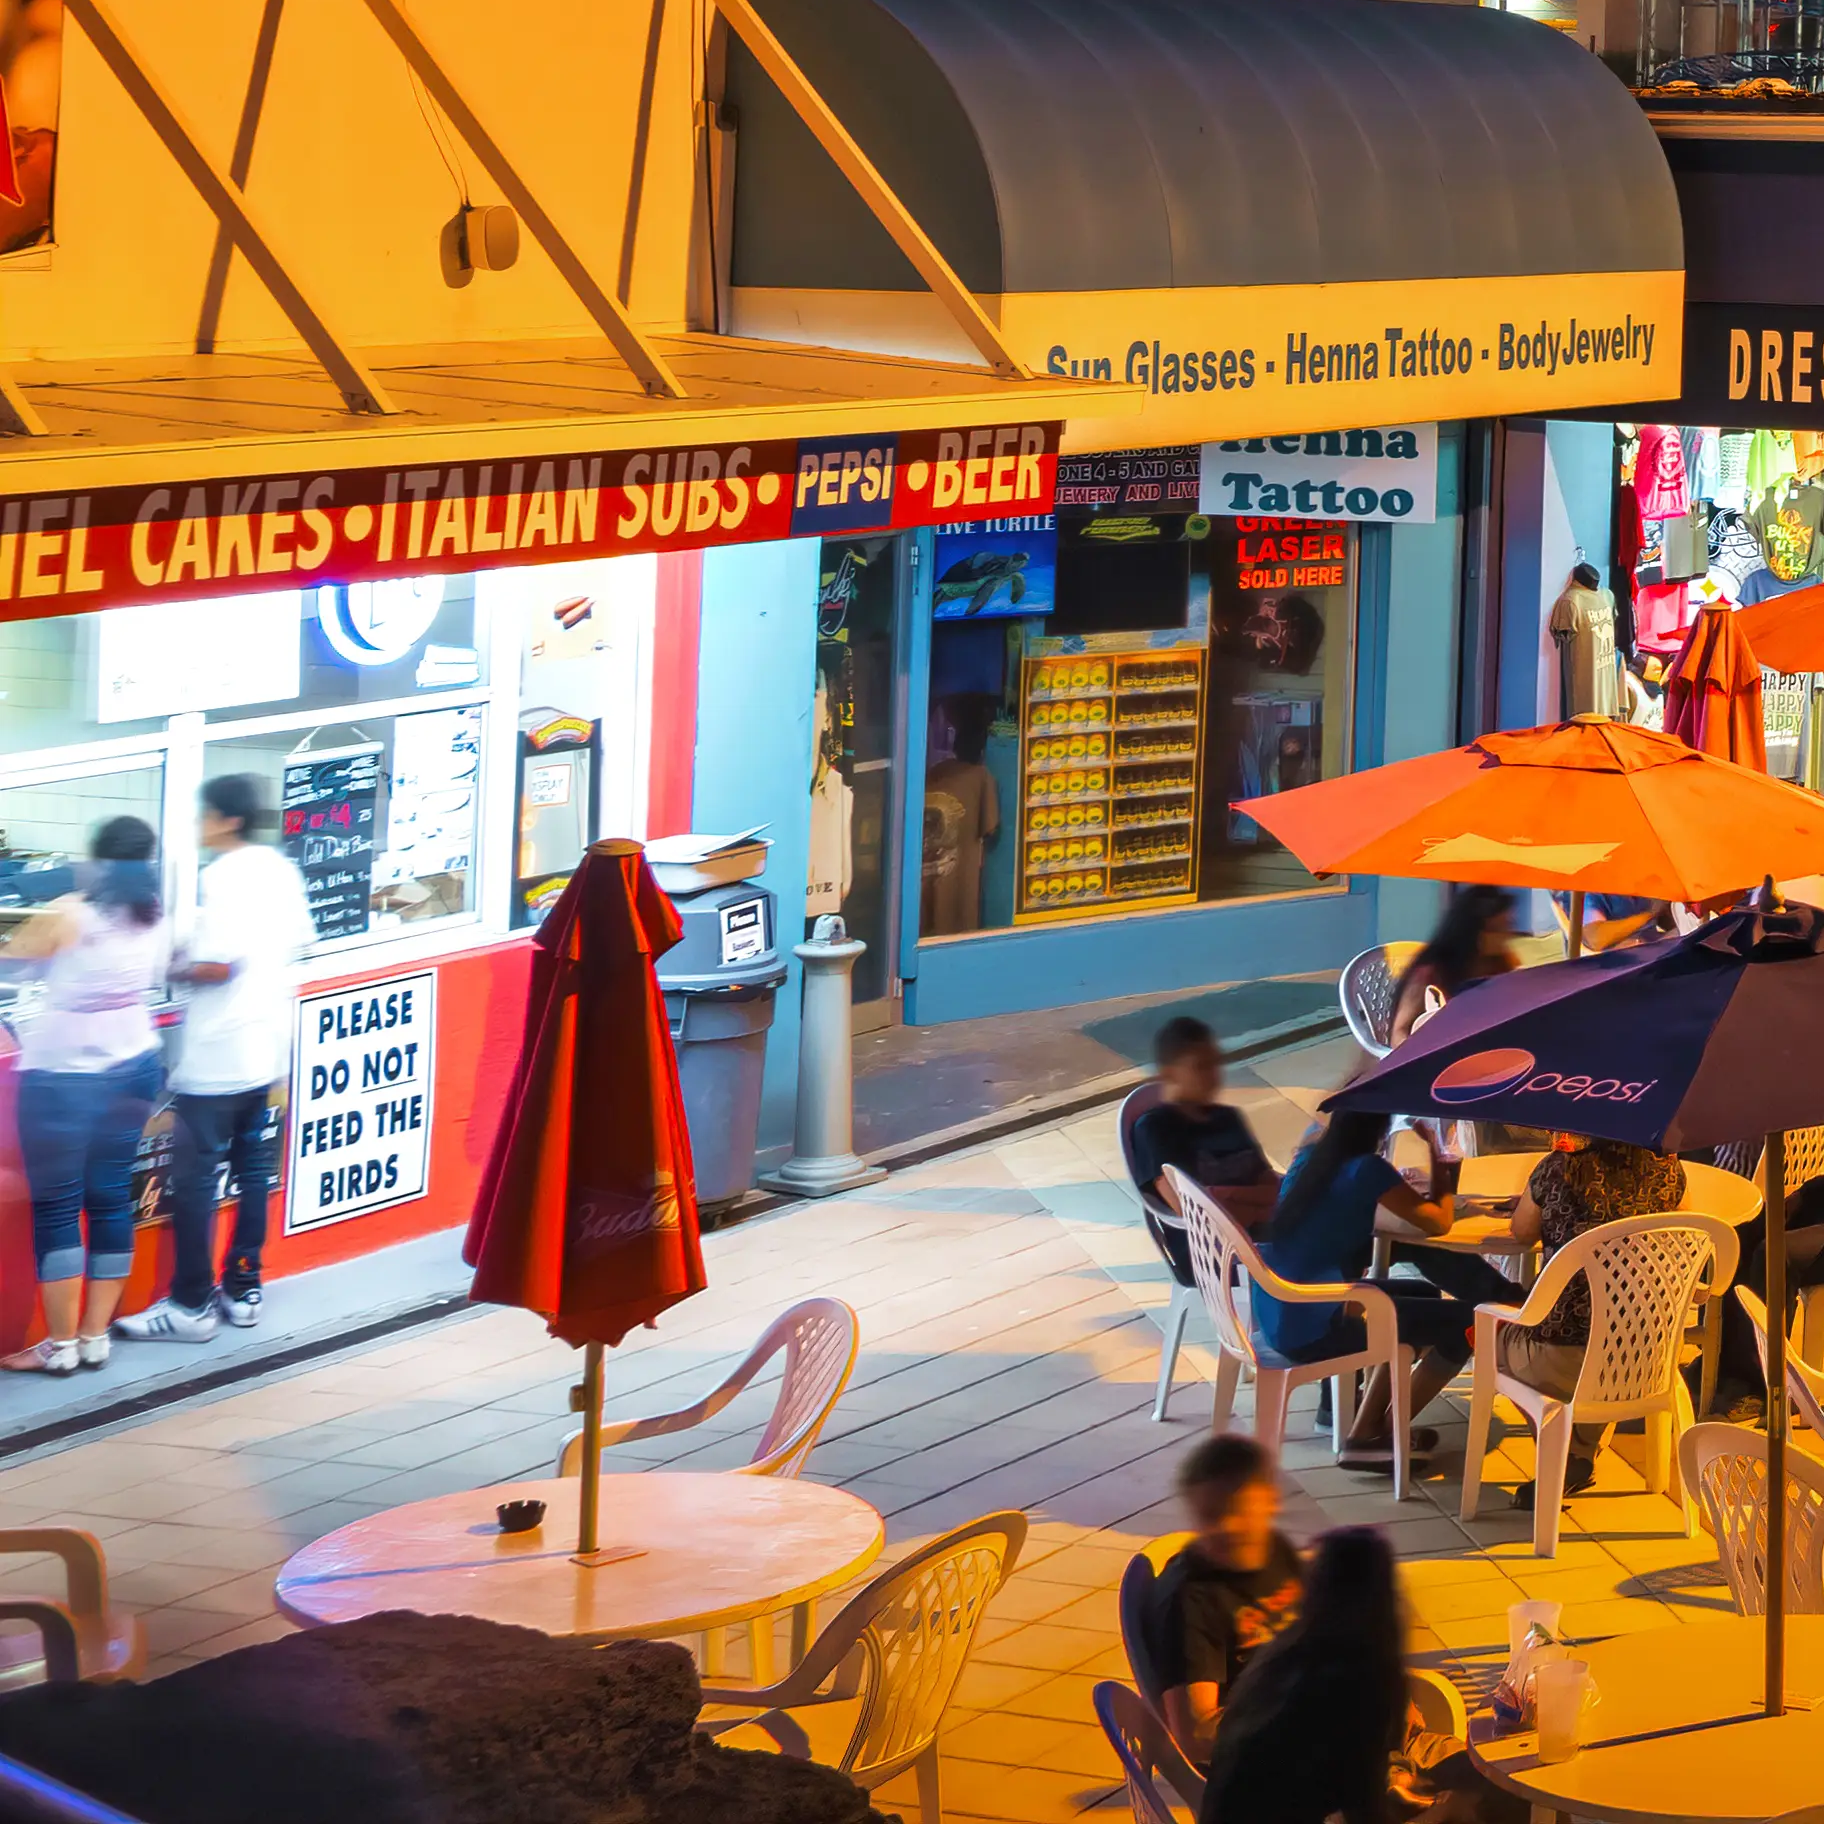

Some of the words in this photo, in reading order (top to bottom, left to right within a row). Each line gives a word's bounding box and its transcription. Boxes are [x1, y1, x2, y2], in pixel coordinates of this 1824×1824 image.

[1047, 345, 1112, 379] Sun
[1125, 340, 1255, 395] Glasses
[1285, 332, 1378, 385] Henna
[1384, 327, 1472, 379] Tattoo
[1125, 484, 1161, 502] AND
[1132, 461, 1168, 479] AND
[1222, 471, 1415, 518] Tattoo
[131, 477, 335, 587] CAKES
[377, 457, 602, 563] ITALIAN
[617, 447, 751, 539] SUBS
[796, 447, 893, 508] PEPSI
[932, 426, 1045, 509] BEER
[1237, 533, 1345, 564] LASER
[1239, 568, 1288, 590] SOLD
[1293, 565, 1342, 587] HERE
[318, 989, 413, 1044] PLEASE
[311, 1059, 350, 1100] DO
[362, 1042, 418, 1089] NOT
[1514, 1072, 1658, 1104] pepsi
[300, 1110, 363, 1157] FEED
[376, 1094, 422, 1137] THE
[319, 1154, 399, 1207] BIRDS
